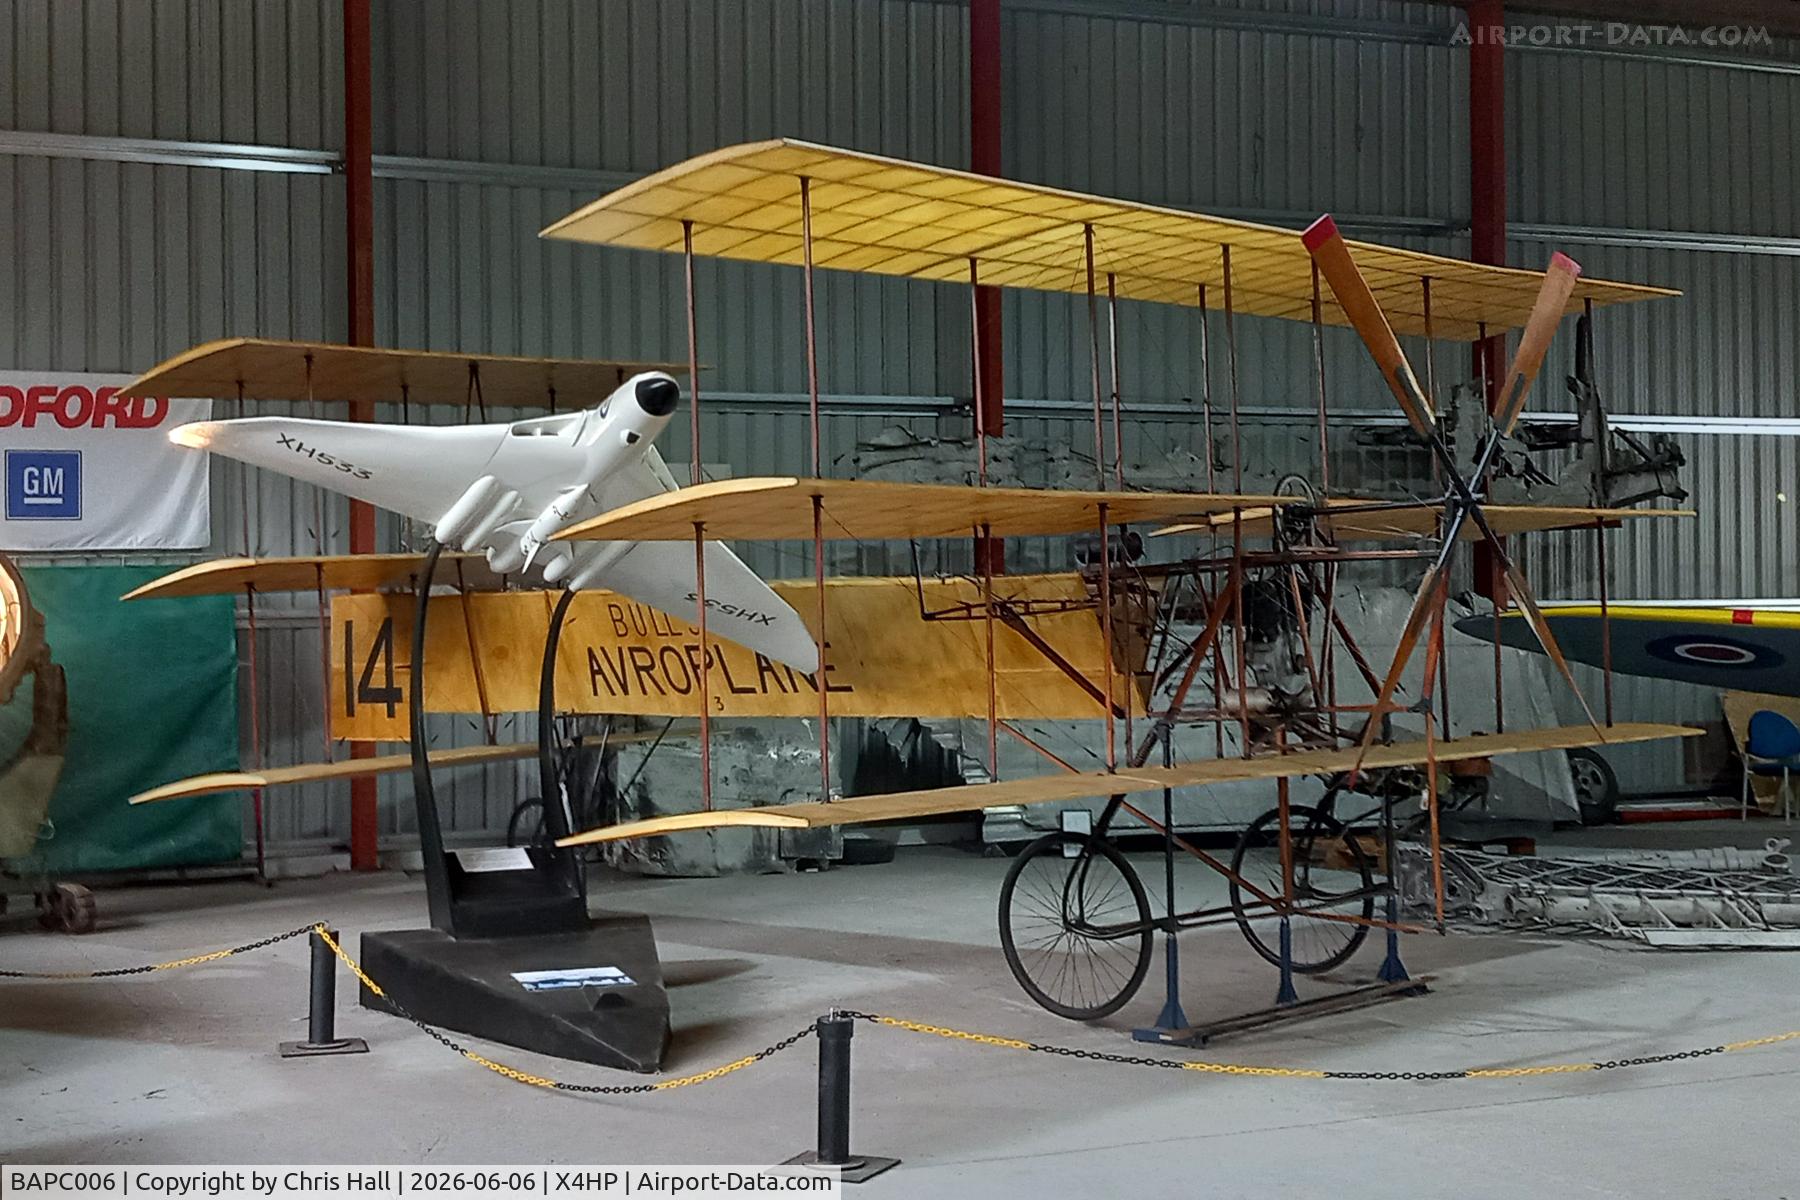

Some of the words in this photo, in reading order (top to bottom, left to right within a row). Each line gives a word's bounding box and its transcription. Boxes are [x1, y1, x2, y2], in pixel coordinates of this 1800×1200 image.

[276, 432, 373, 480] XH533
[23, 466, 64, 495] GM
[345, 616, 404, 719] 14
[713, 695, 725, 712] 3
